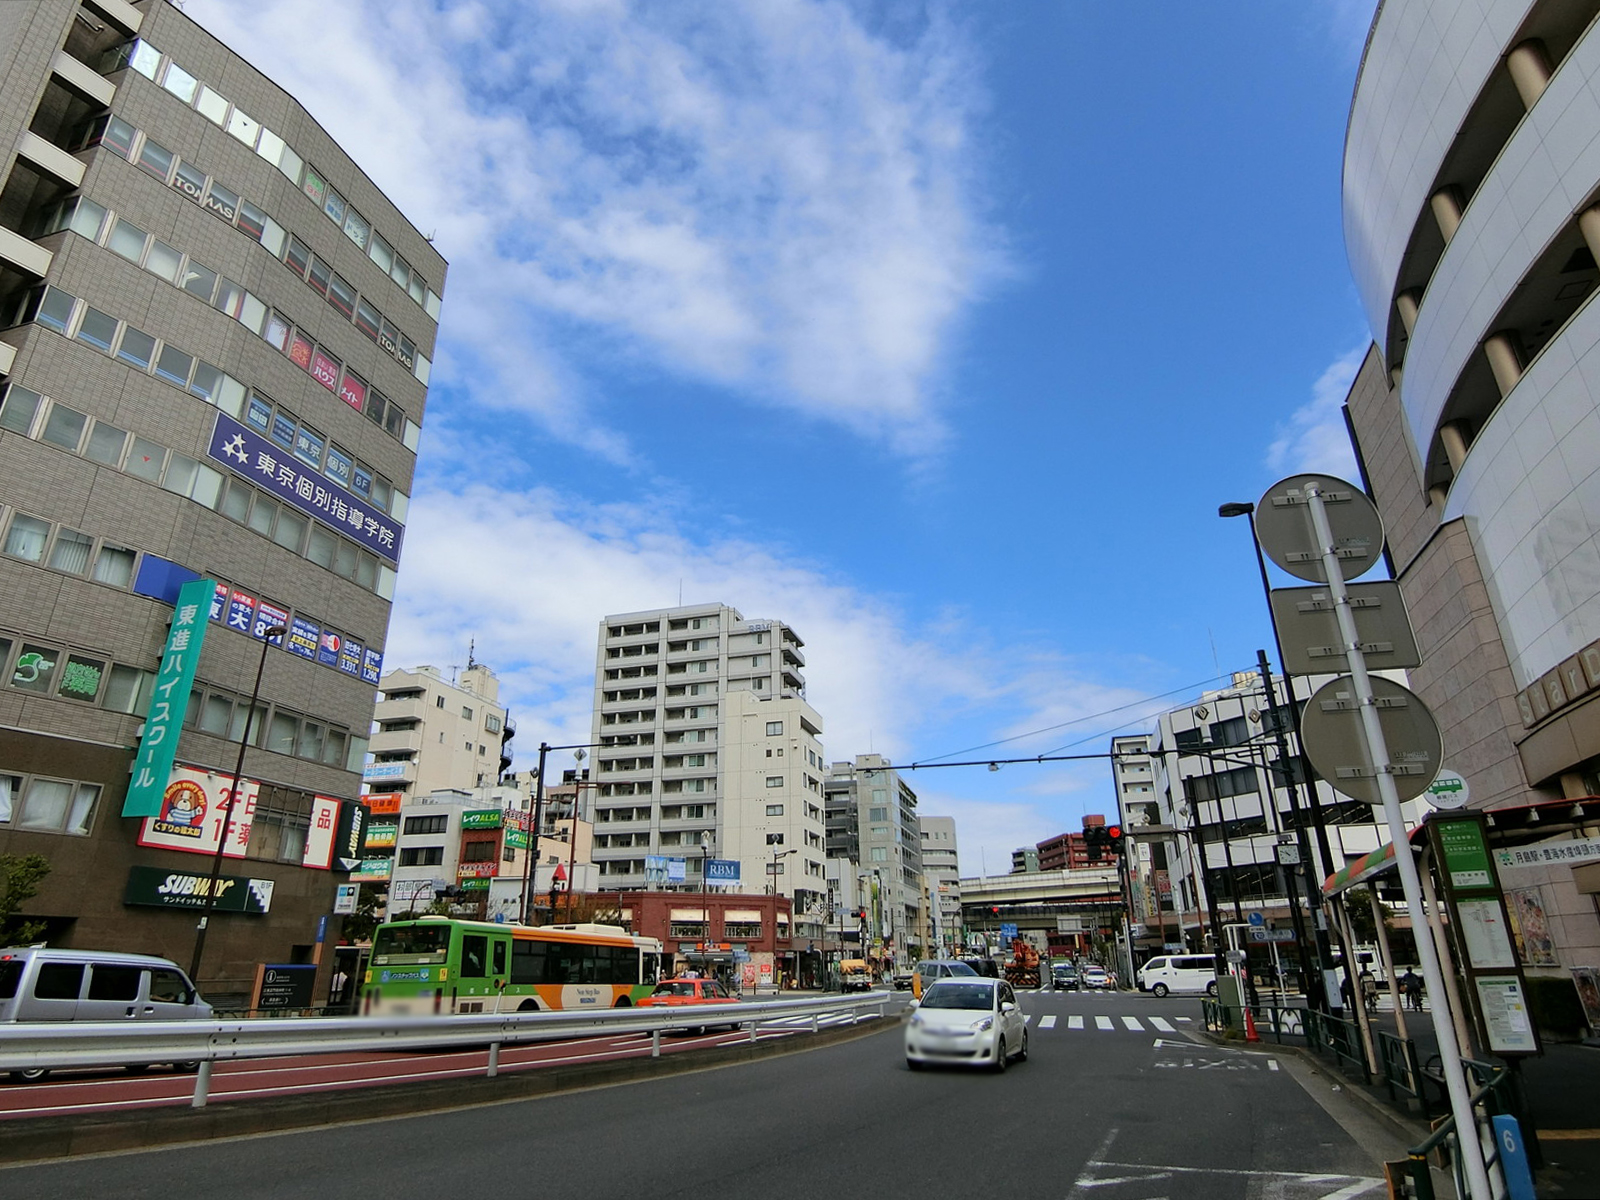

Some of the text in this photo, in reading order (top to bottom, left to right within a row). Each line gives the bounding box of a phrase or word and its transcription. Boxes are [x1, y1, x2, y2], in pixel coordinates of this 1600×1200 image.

[313, 365, 335, 388] ハウス
[341, 386, 359, 404] メイト
[298, 433, 369, 490] 東京 個別 6F
[255, 451, 395, 550] 東京個別指導学院
[229, 611, 249, 630] 大
[134, 604, 199, 789] 東進ハイスクール
[216, 787, 243, 812] 2F
[213, 818, 237, 842] 1F
[317, 808, 331, 830] 品
[348, 806, 363, 858] SUBWAY
[709, 864, 735, 876] RBM
[158, 874, 235, 898] SUBWY
[260, 881, 273, 889] B1F
[1503, 1129, 1516, 1153] 6
